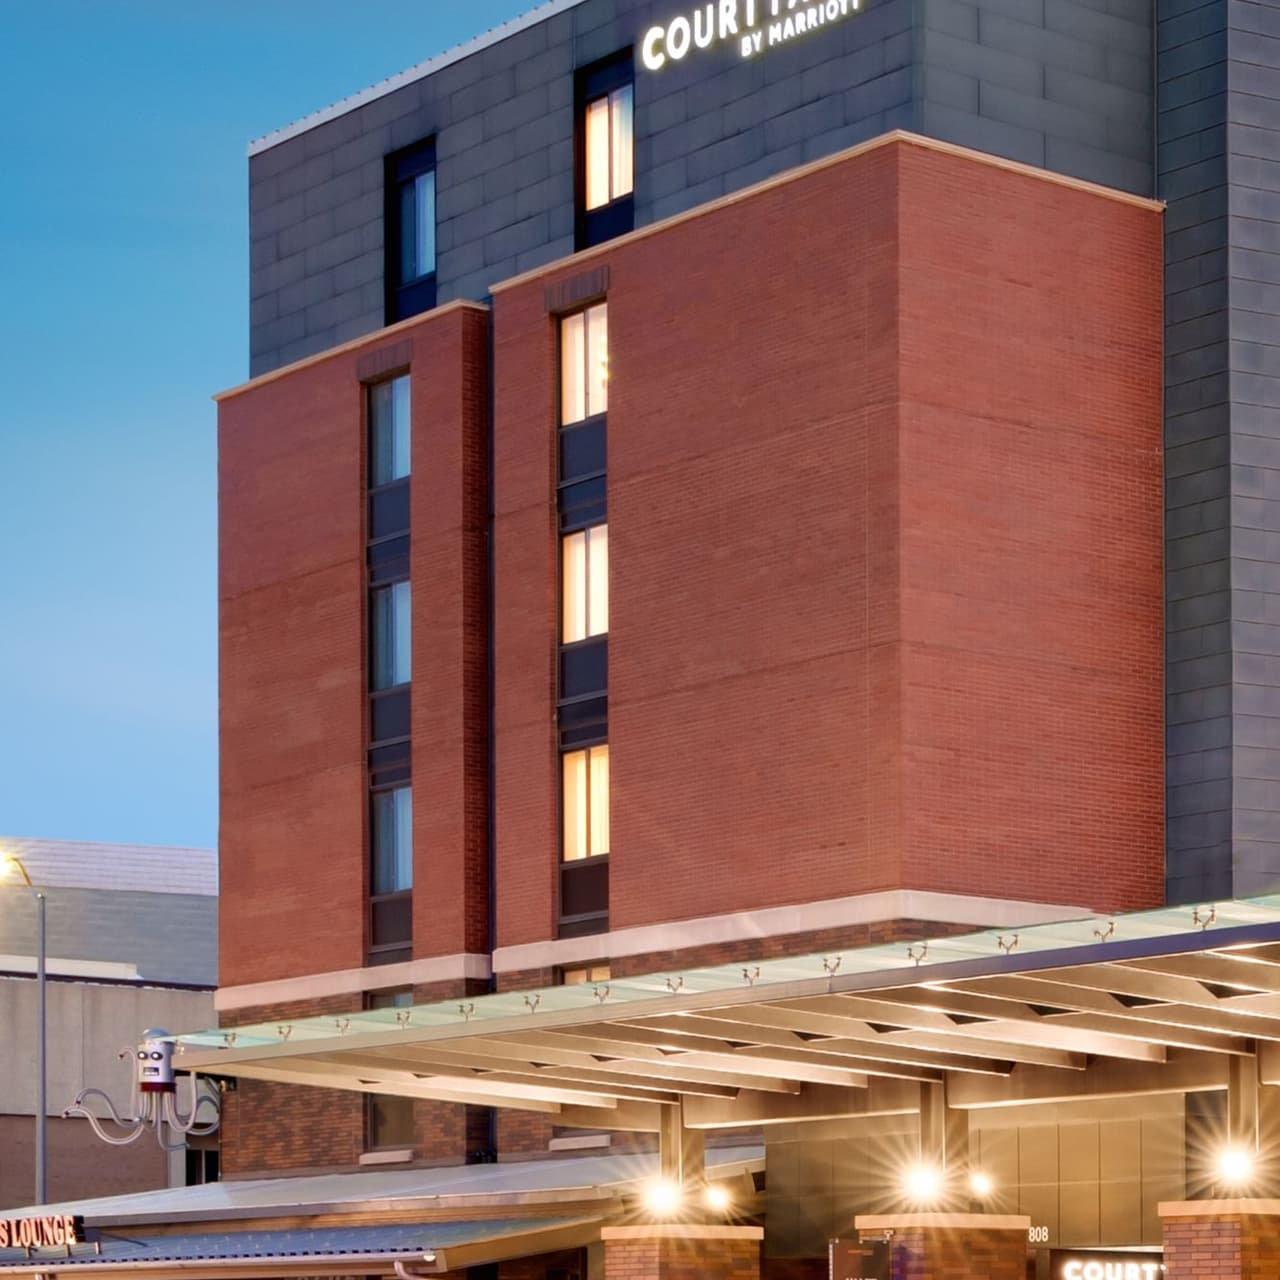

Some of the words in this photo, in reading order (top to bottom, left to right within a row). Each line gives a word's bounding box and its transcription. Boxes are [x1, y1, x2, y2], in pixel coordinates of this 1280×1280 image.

[741, 28, 763, 57] BY
[10, 1214, 77, 1248] LOUNGE
[1028, 1226, 1049, 1242] 808
